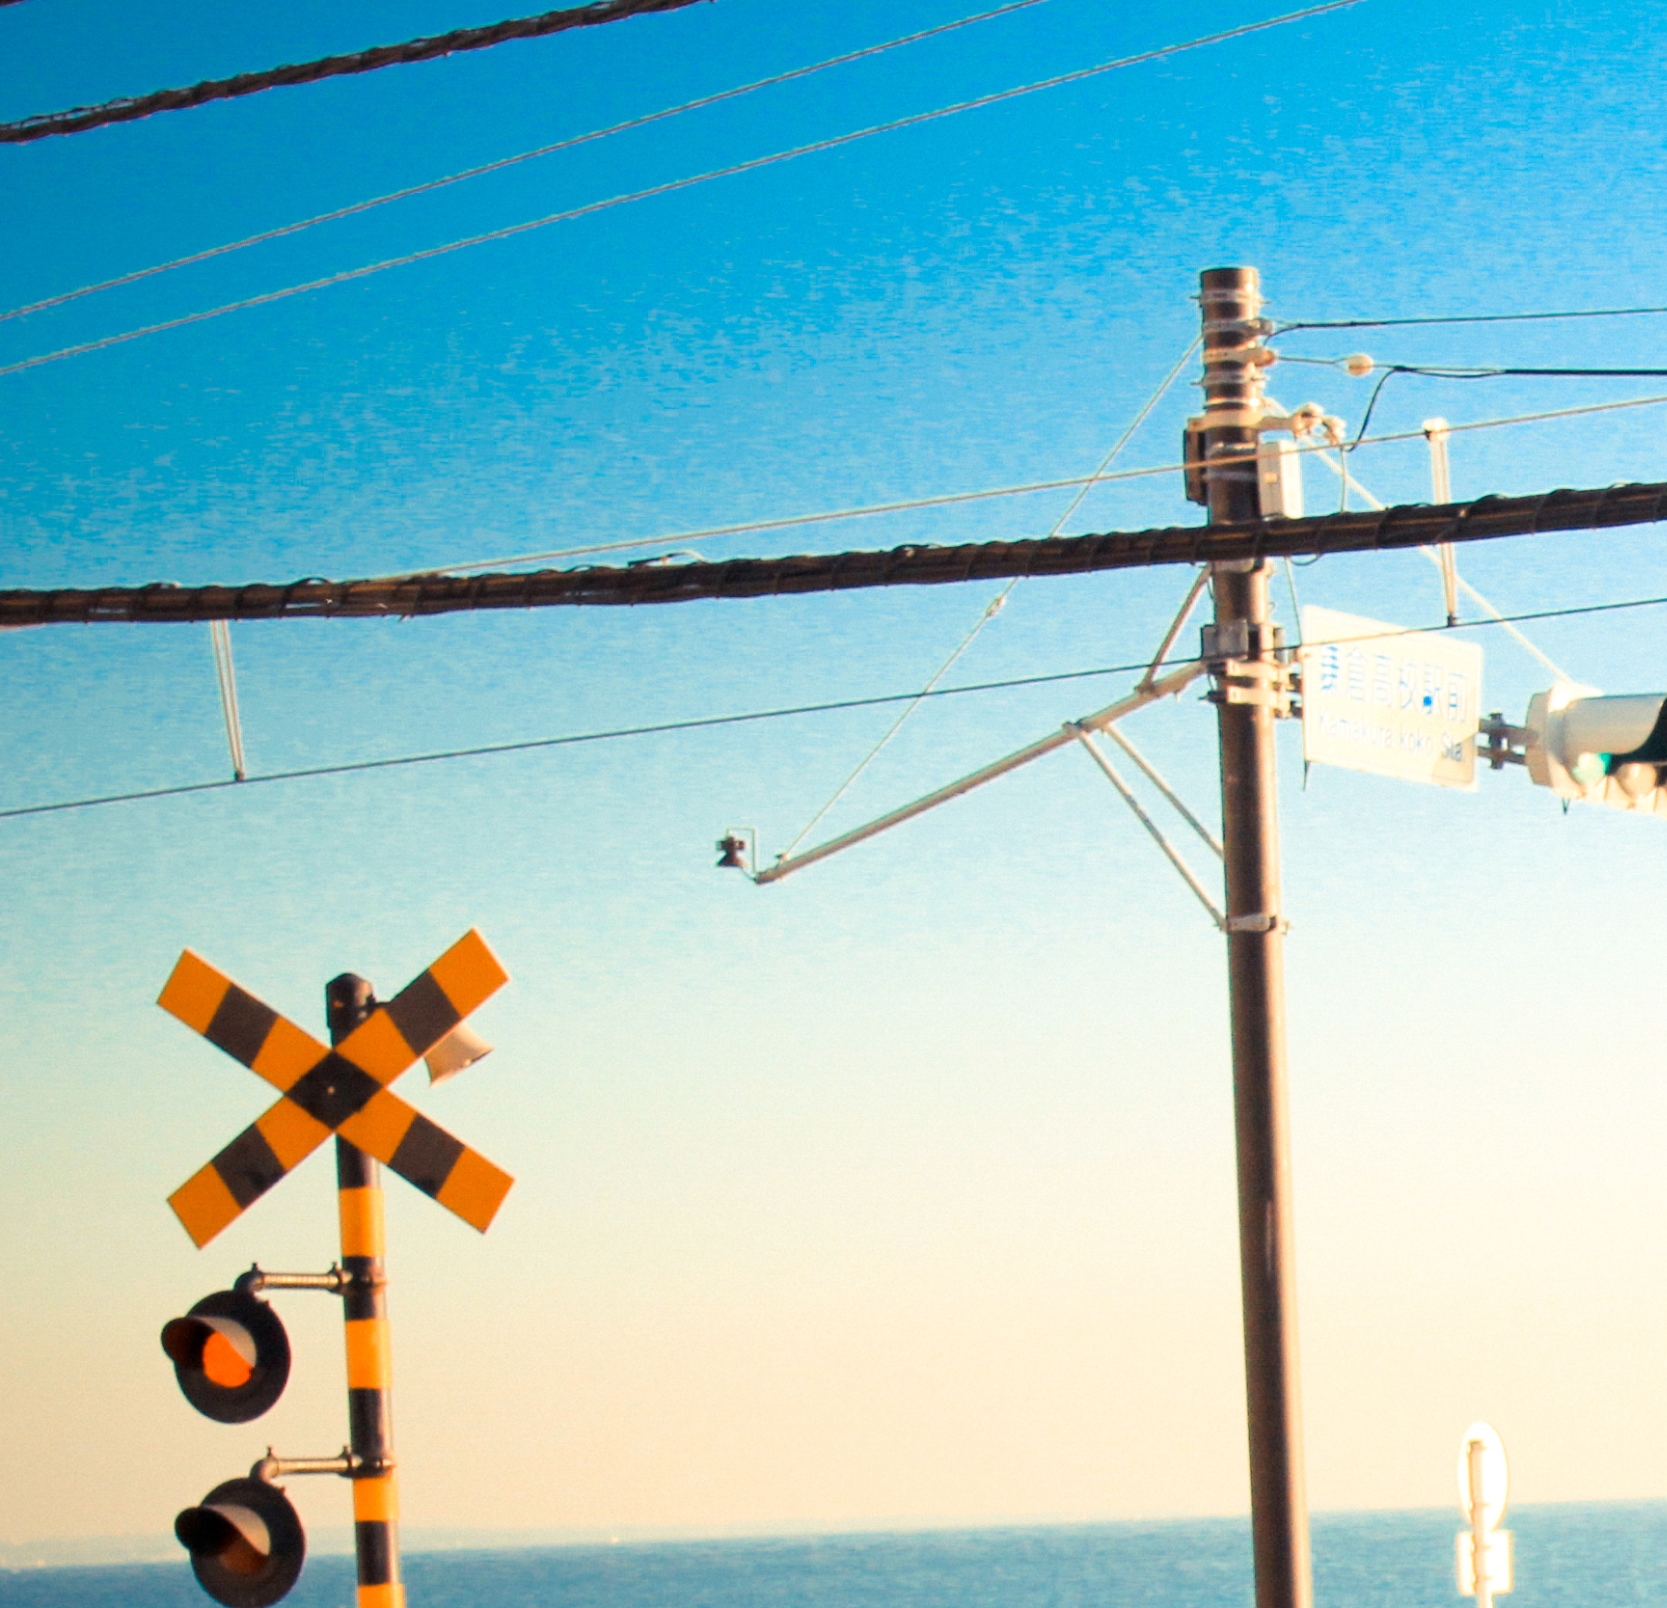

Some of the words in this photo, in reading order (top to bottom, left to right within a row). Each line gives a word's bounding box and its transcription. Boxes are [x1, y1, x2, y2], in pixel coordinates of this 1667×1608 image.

[1319, 644, 1469, 724] 鎌倉高校駅前
